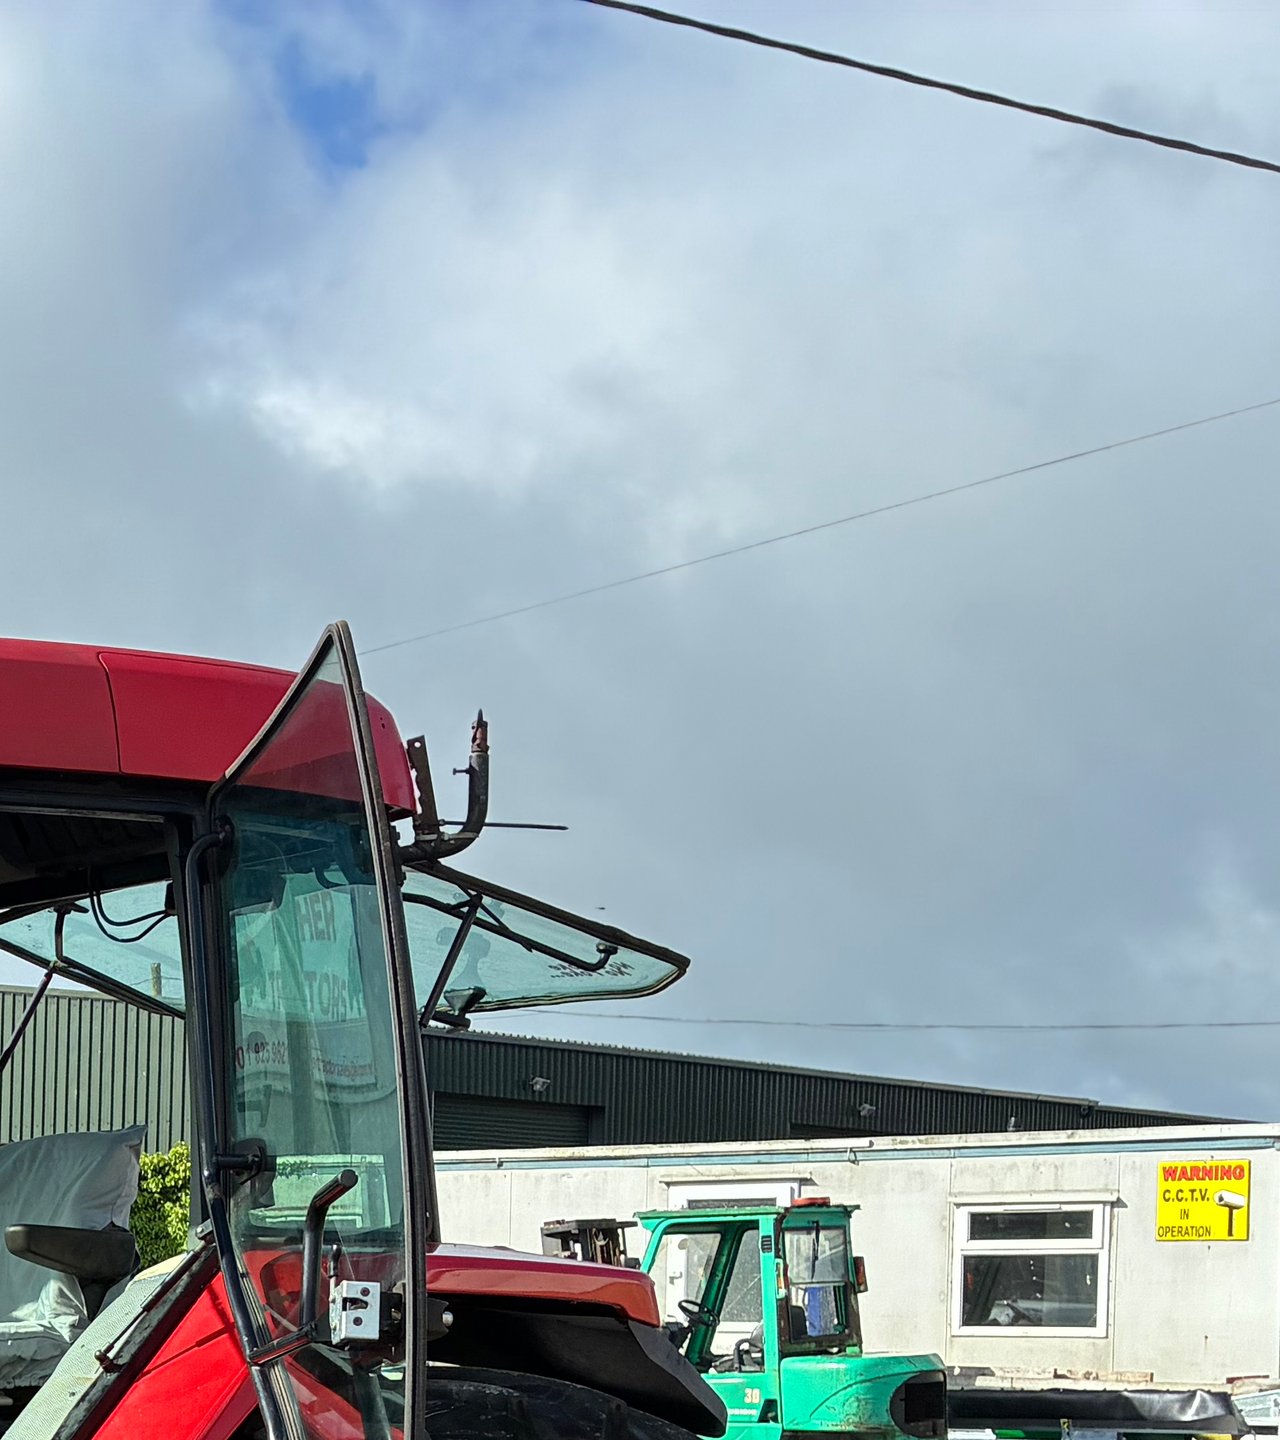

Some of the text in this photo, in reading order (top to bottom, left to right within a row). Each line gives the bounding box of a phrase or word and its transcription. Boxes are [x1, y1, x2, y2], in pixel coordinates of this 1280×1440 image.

[1162, 1164, 1245, 1182] WARNING
[1163, 1188, 1210, 1202] C.C.T.V.
[1180, 1208, 1190, 1220] IN
[1157, 1225, 1212, 1238] OPERATION
[744, 1388, 760, 1404] 30
